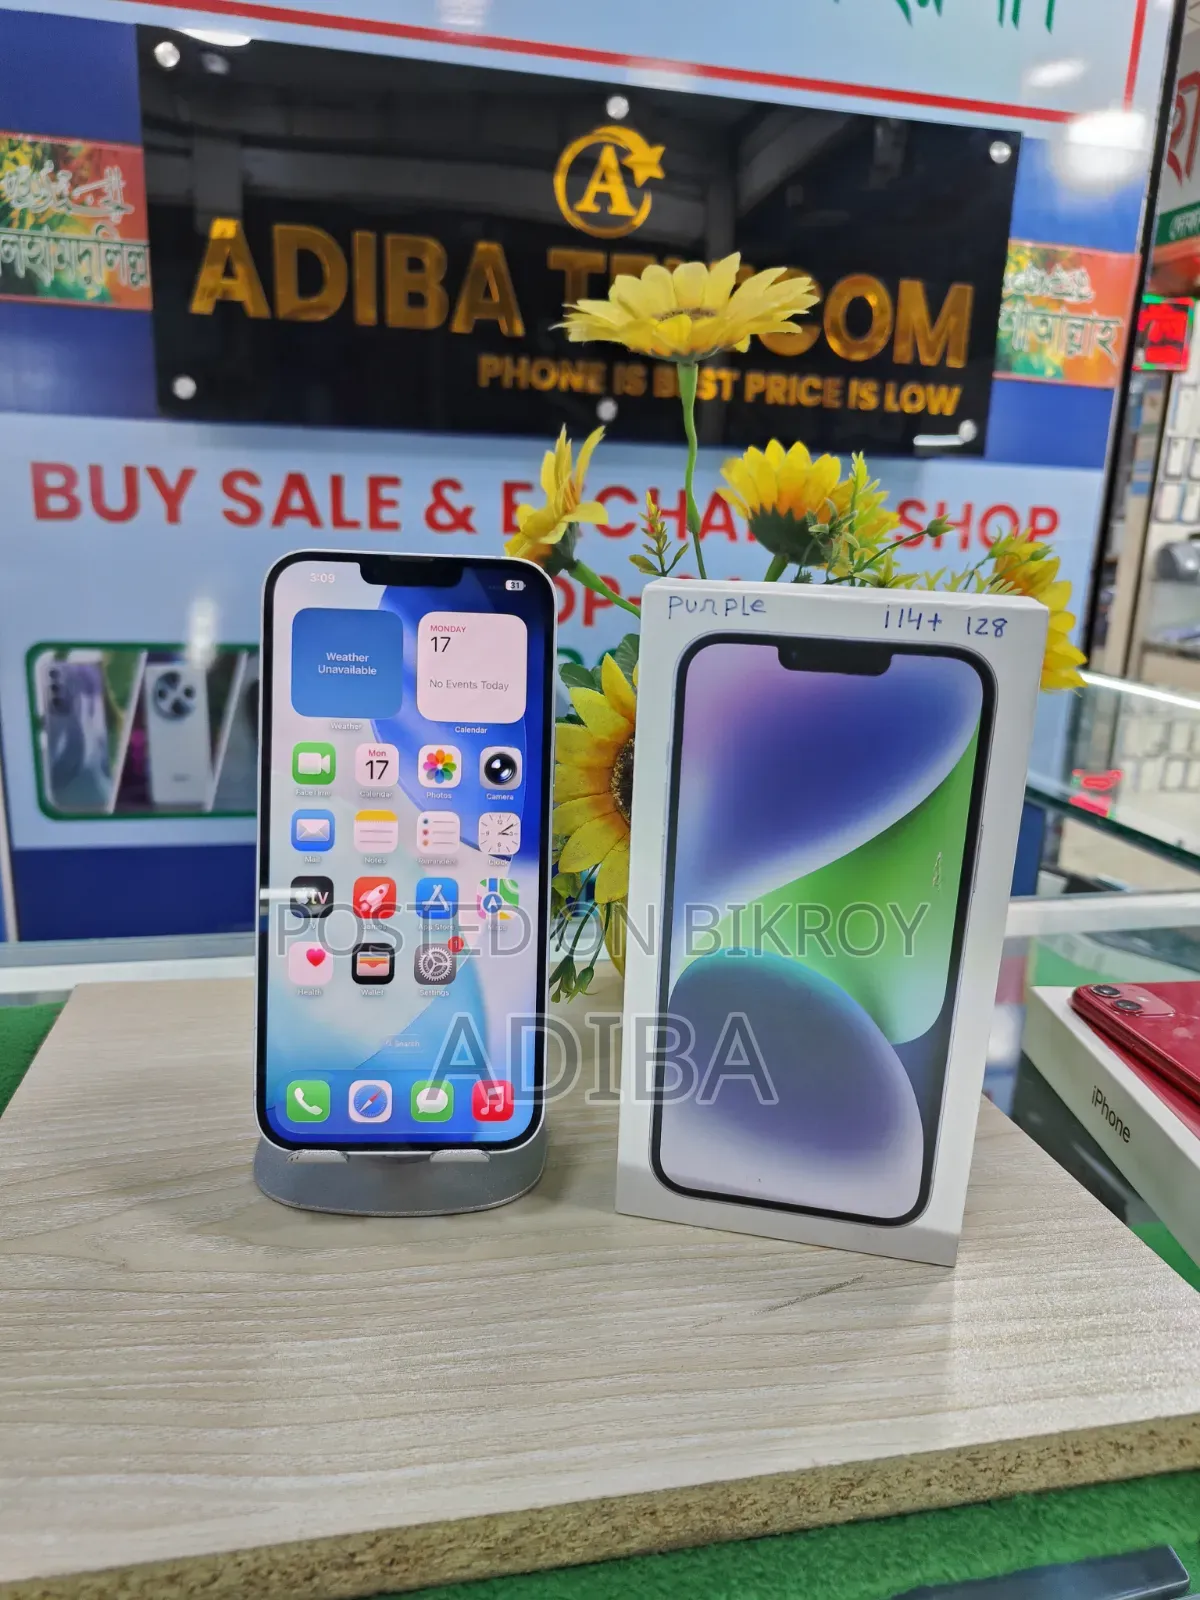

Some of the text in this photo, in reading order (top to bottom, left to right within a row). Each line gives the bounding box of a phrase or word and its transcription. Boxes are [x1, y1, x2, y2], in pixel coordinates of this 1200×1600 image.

[189, 218, 974, 368] ADIBA TCOM
[477, 354, 606, 394] PHONE
[613, 363, 646, 397] IS
[745, 371, 841, 409] PRICE
[848, 379, 880, 412] IS
[884, 380, 962, 416] LOW
[30, 462, 196, 524] BUY
[221, 469, 401, 532] SALE
[425, 478, 478, 534] &
[896, 499, 1060, 550] SHOP
[309, 572, 336, 584] 3:09
[430, 625, 466, 633] MONDAY
[966, 616, 1008, 638] 128
[430, 636, 451, 653] 17
[326, 652, 369, 662] Weather
[318, 664, 377, 676] Unavailable
[430, 679, 509, 692] No Events Today
[330, 722, 362, 731] Weather
[455, 726, 487, 735] Calendar
[368, 749, 387, 757] Mon
[365, 760, 389, 780] 17
[359, 790, 393, 799] Calendar
[426, 791, 452, 799] Photos
[486, 793, 514, 801] Camera
[364, 857, 387, 865] Notes
[297, 988, 321, 997] Health
[361, 988, 385, 996] Wallet
[419, 988, 450, 998] Settings
[1091, 1085, 1131, 1143] iPhone
